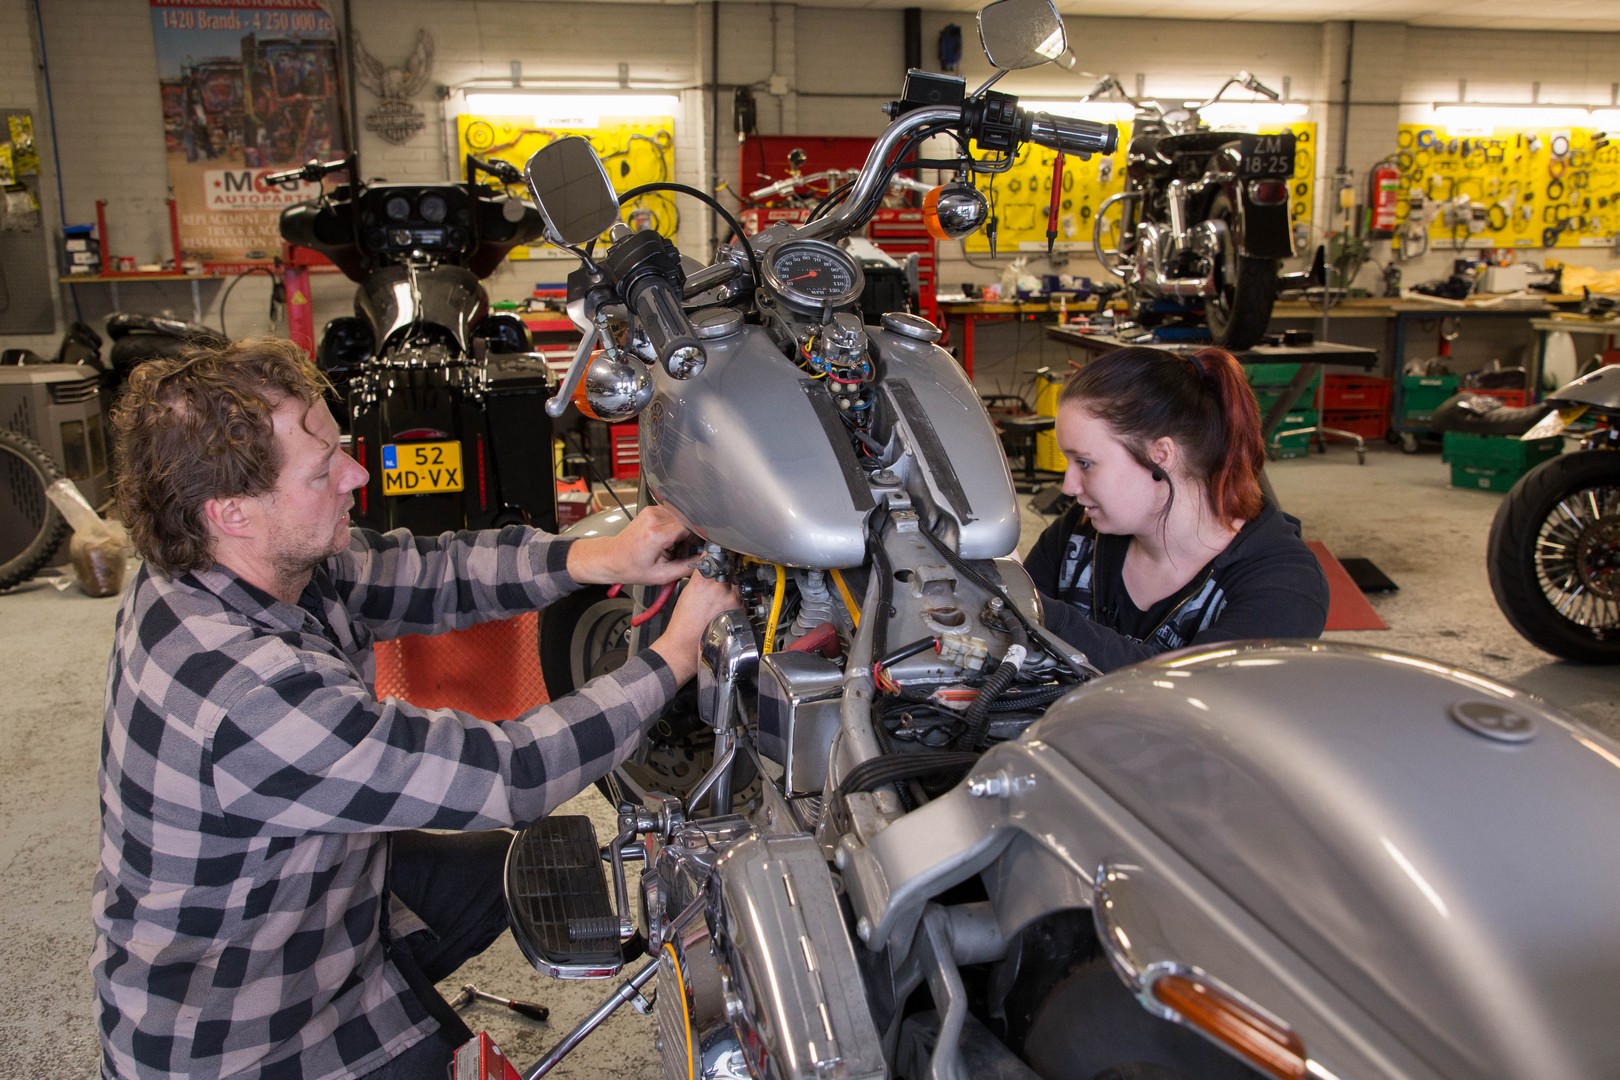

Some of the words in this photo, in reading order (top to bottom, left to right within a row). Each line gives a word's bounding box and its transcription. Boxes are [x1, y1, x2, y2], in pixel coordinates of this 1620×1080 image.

[162, 10, 195, 29] 1420
[198, 9, 241, 31] Brands
[1254, 137, 1281, 154] ZM
[1245, 156, 1288, 173] 18-25
[415, 447, 444, 465] 52
[386, 468, 459, 490] MD-VX
